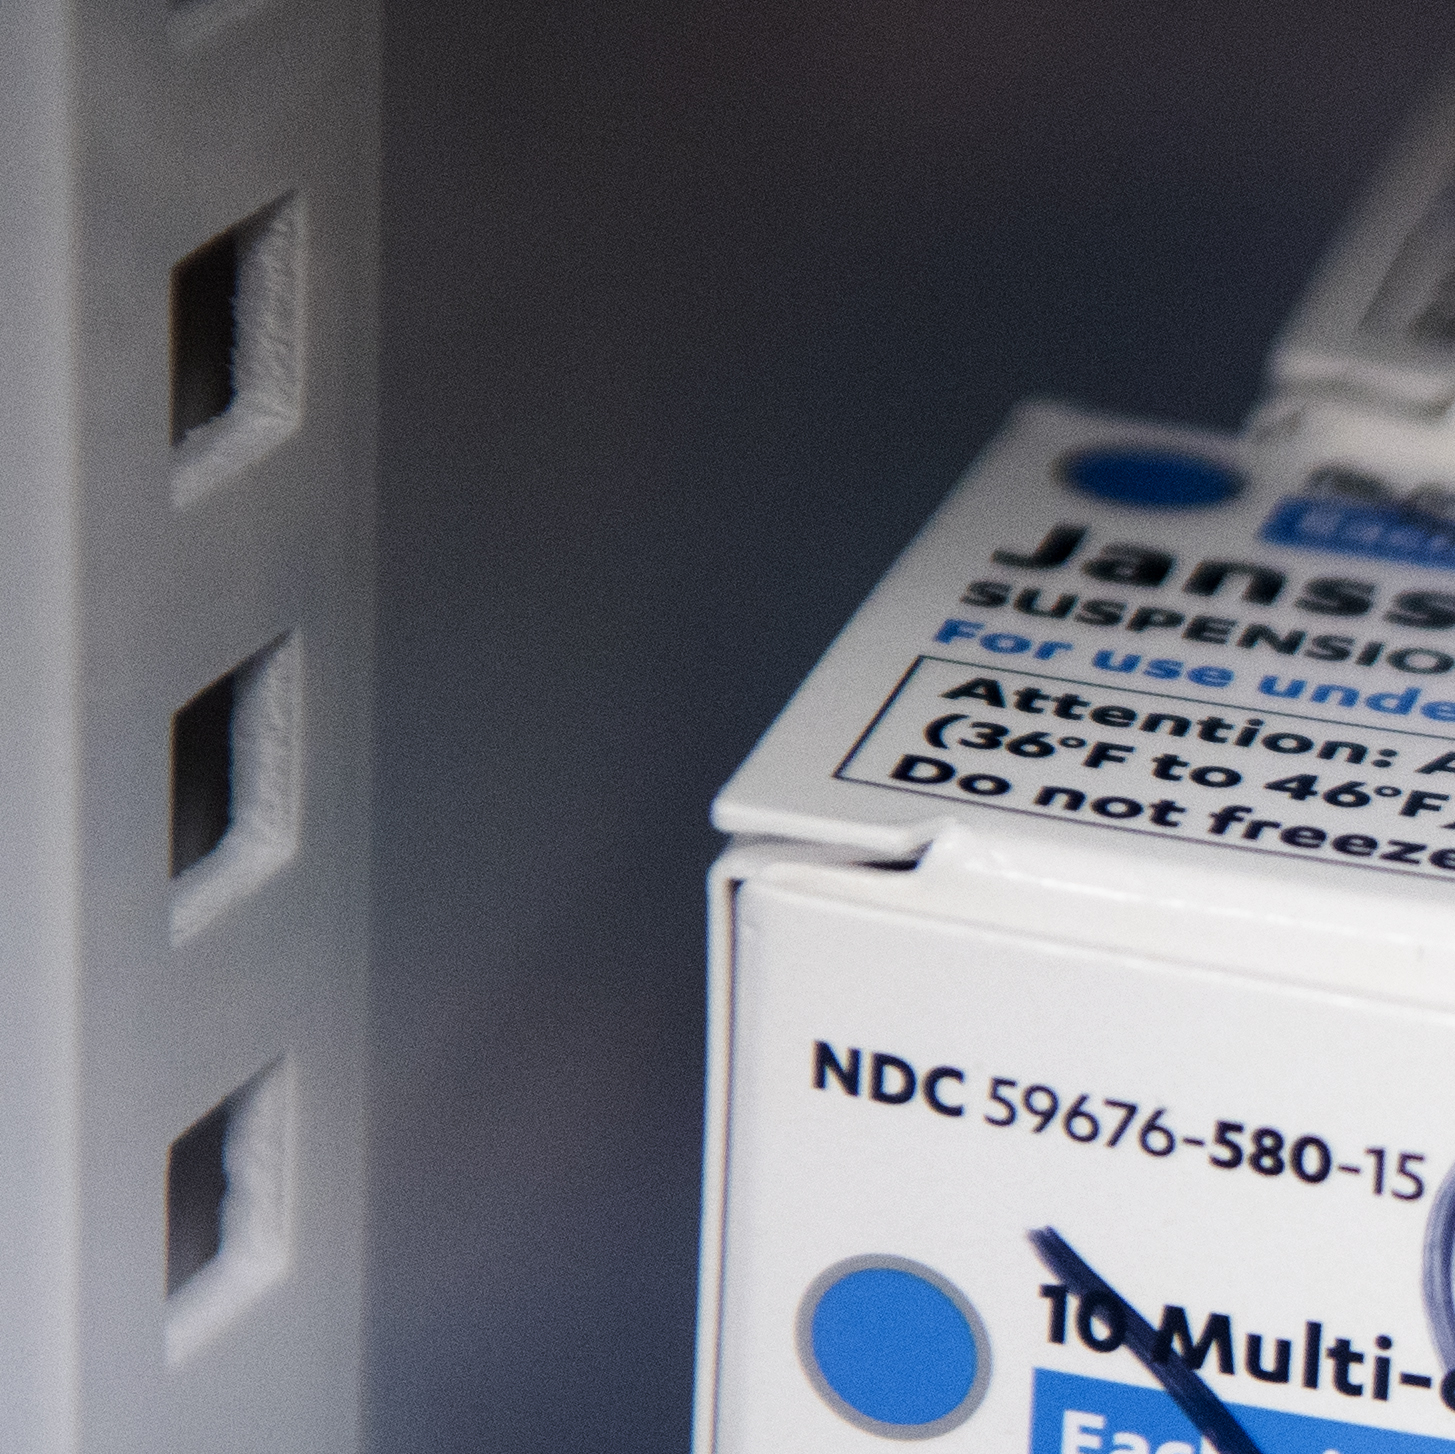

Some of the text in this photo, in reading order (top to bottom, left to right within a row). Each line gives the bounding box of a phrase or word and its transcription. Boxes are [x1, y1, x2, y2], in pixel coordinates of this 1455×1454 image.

[929, 617, 1072, 663] For
[1091, 647, 1236, 689] use
[922, 711, 1136, 772] (36°F
[1150, 748, 1242, 792] to
[939, 676, 1398, 772] Attention:
[887, 753, 1011, 799] Do
[1032, 781, 1182, 830] not
[810, 1039, 1428, 1203] NDC 59676-580-15
